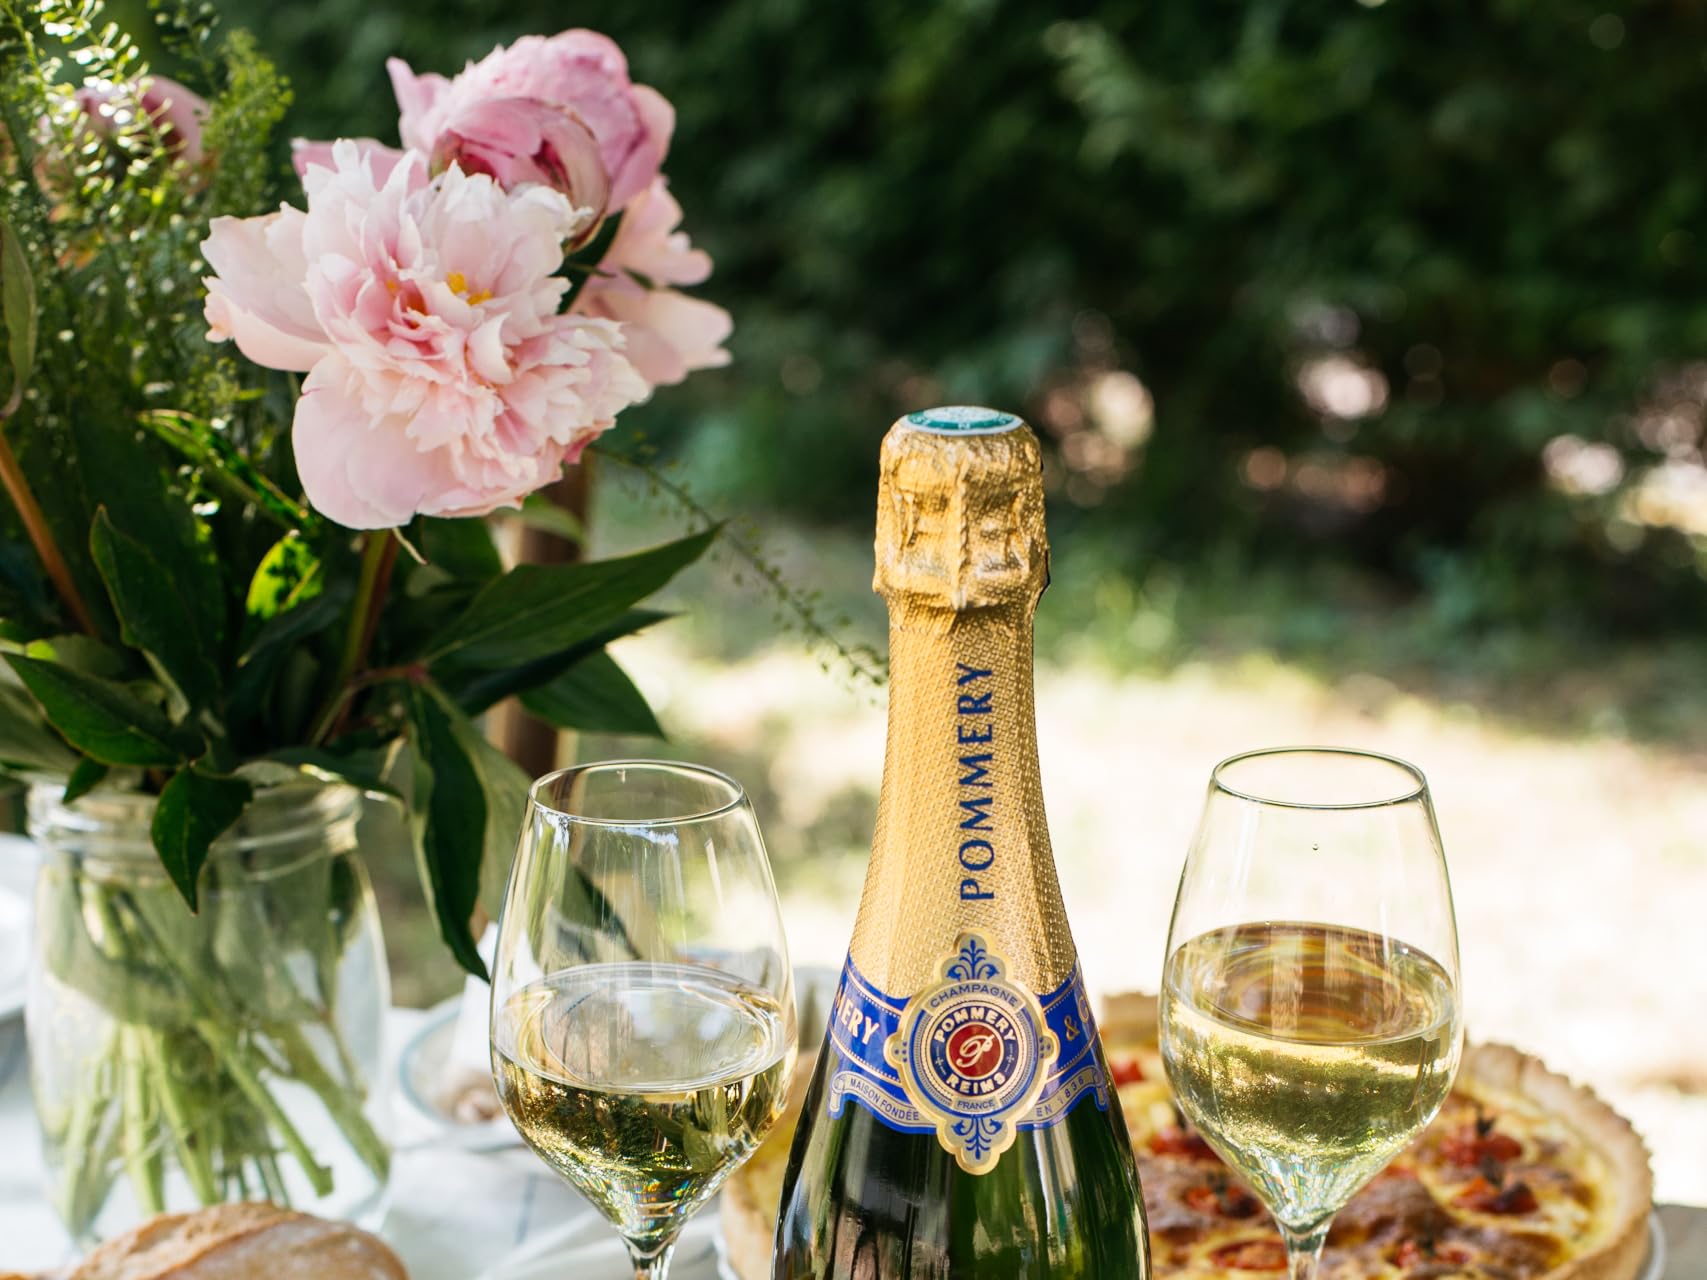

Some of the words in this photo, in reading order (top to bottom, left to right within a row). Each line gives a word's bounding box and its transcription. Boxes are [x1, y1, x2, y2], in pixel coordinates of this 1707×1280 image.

[956, 662, 995, 901] POMMERY
[930, 984, 1018, 1008] CHAMPAGNE
[934, 1007, 1016, 1043] POMMERY
[850, 1078, 880, 1103] MAISON
[946, 1072, 1005, 1095] REIMS
[957, 1100, 995, 1110] FRANCE
[1036, 1104, 1053, 1117] EN
